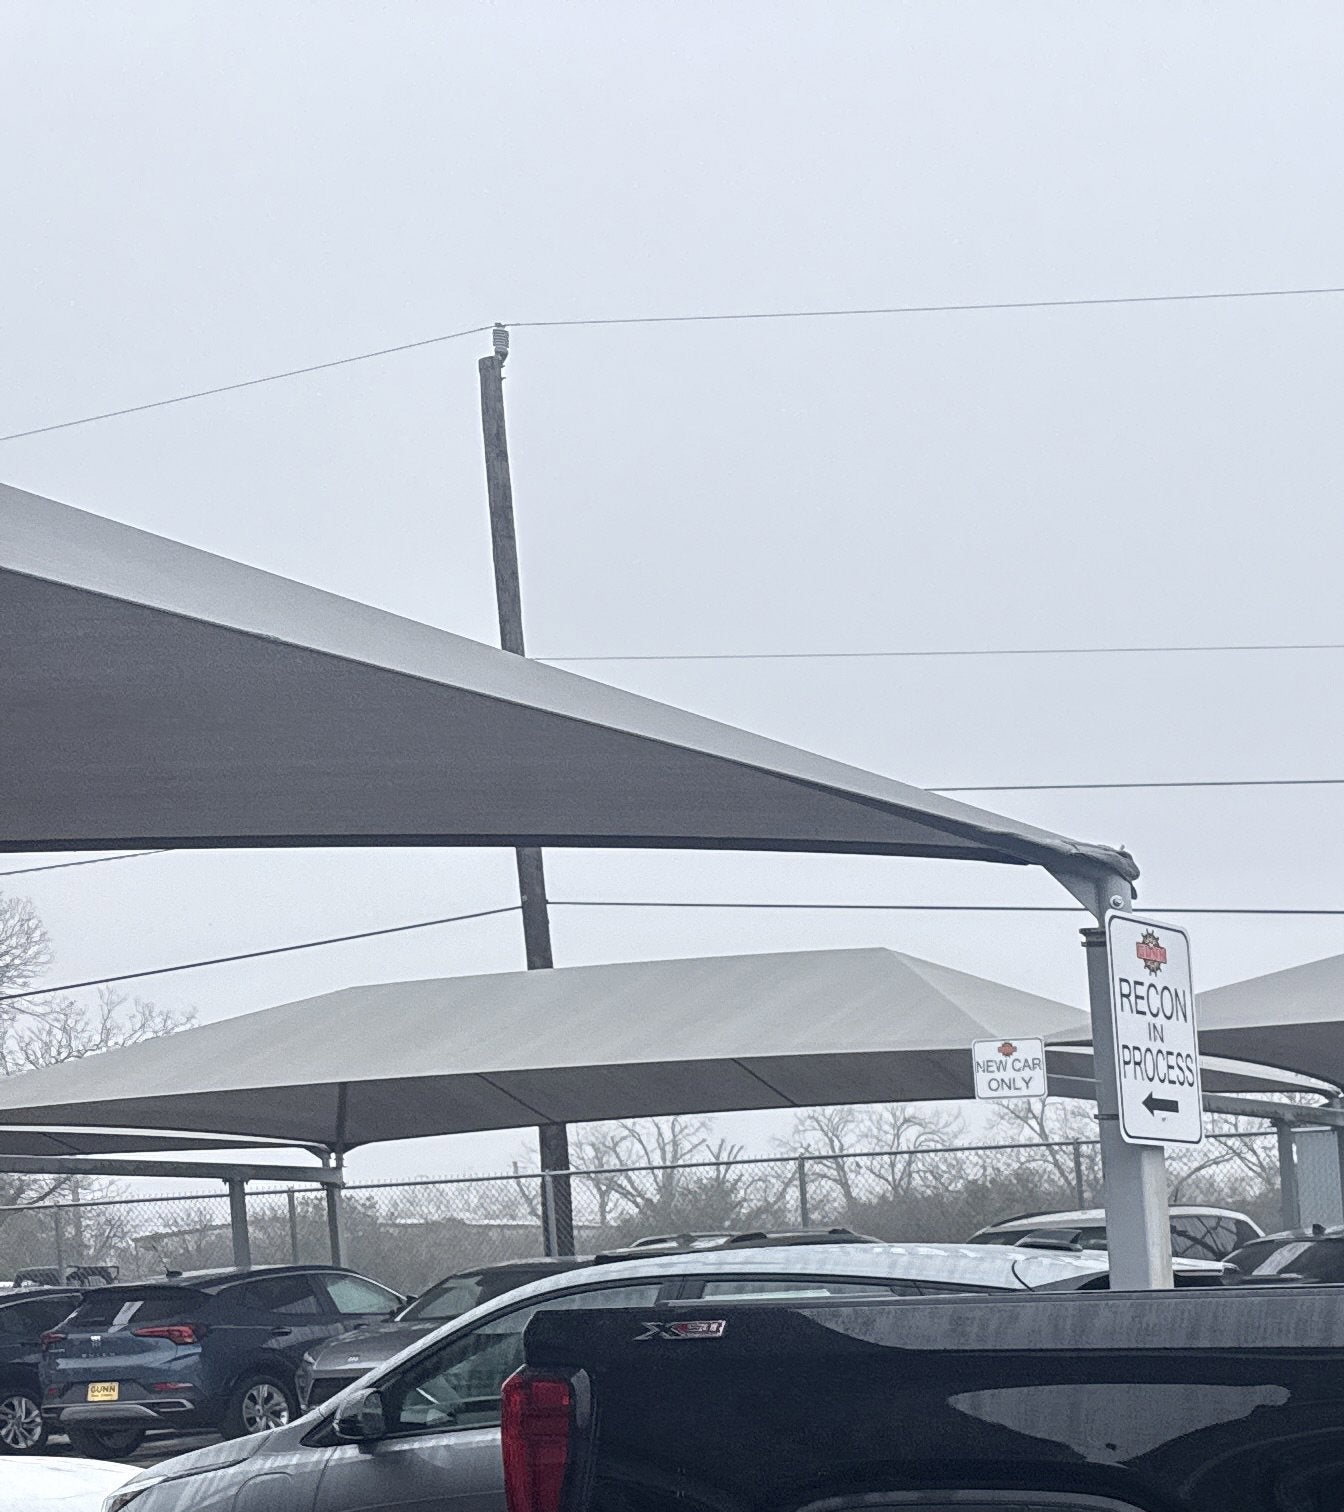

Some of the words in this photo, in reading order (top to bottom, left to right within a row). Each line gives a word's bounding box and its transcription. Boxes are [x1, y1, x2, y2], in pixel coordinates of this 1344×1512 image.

[1118, 976, 1188, 1024] RECON
[1148, 1022, 1165, 1044] IN
[975, 1058, 1008, 1074] NEW
[1011, 1057, 1042, 1072] CAR
[1121, 1044, 1195, 1088] PROCESS
[988, 1076, 1033, 1092] ONLY
